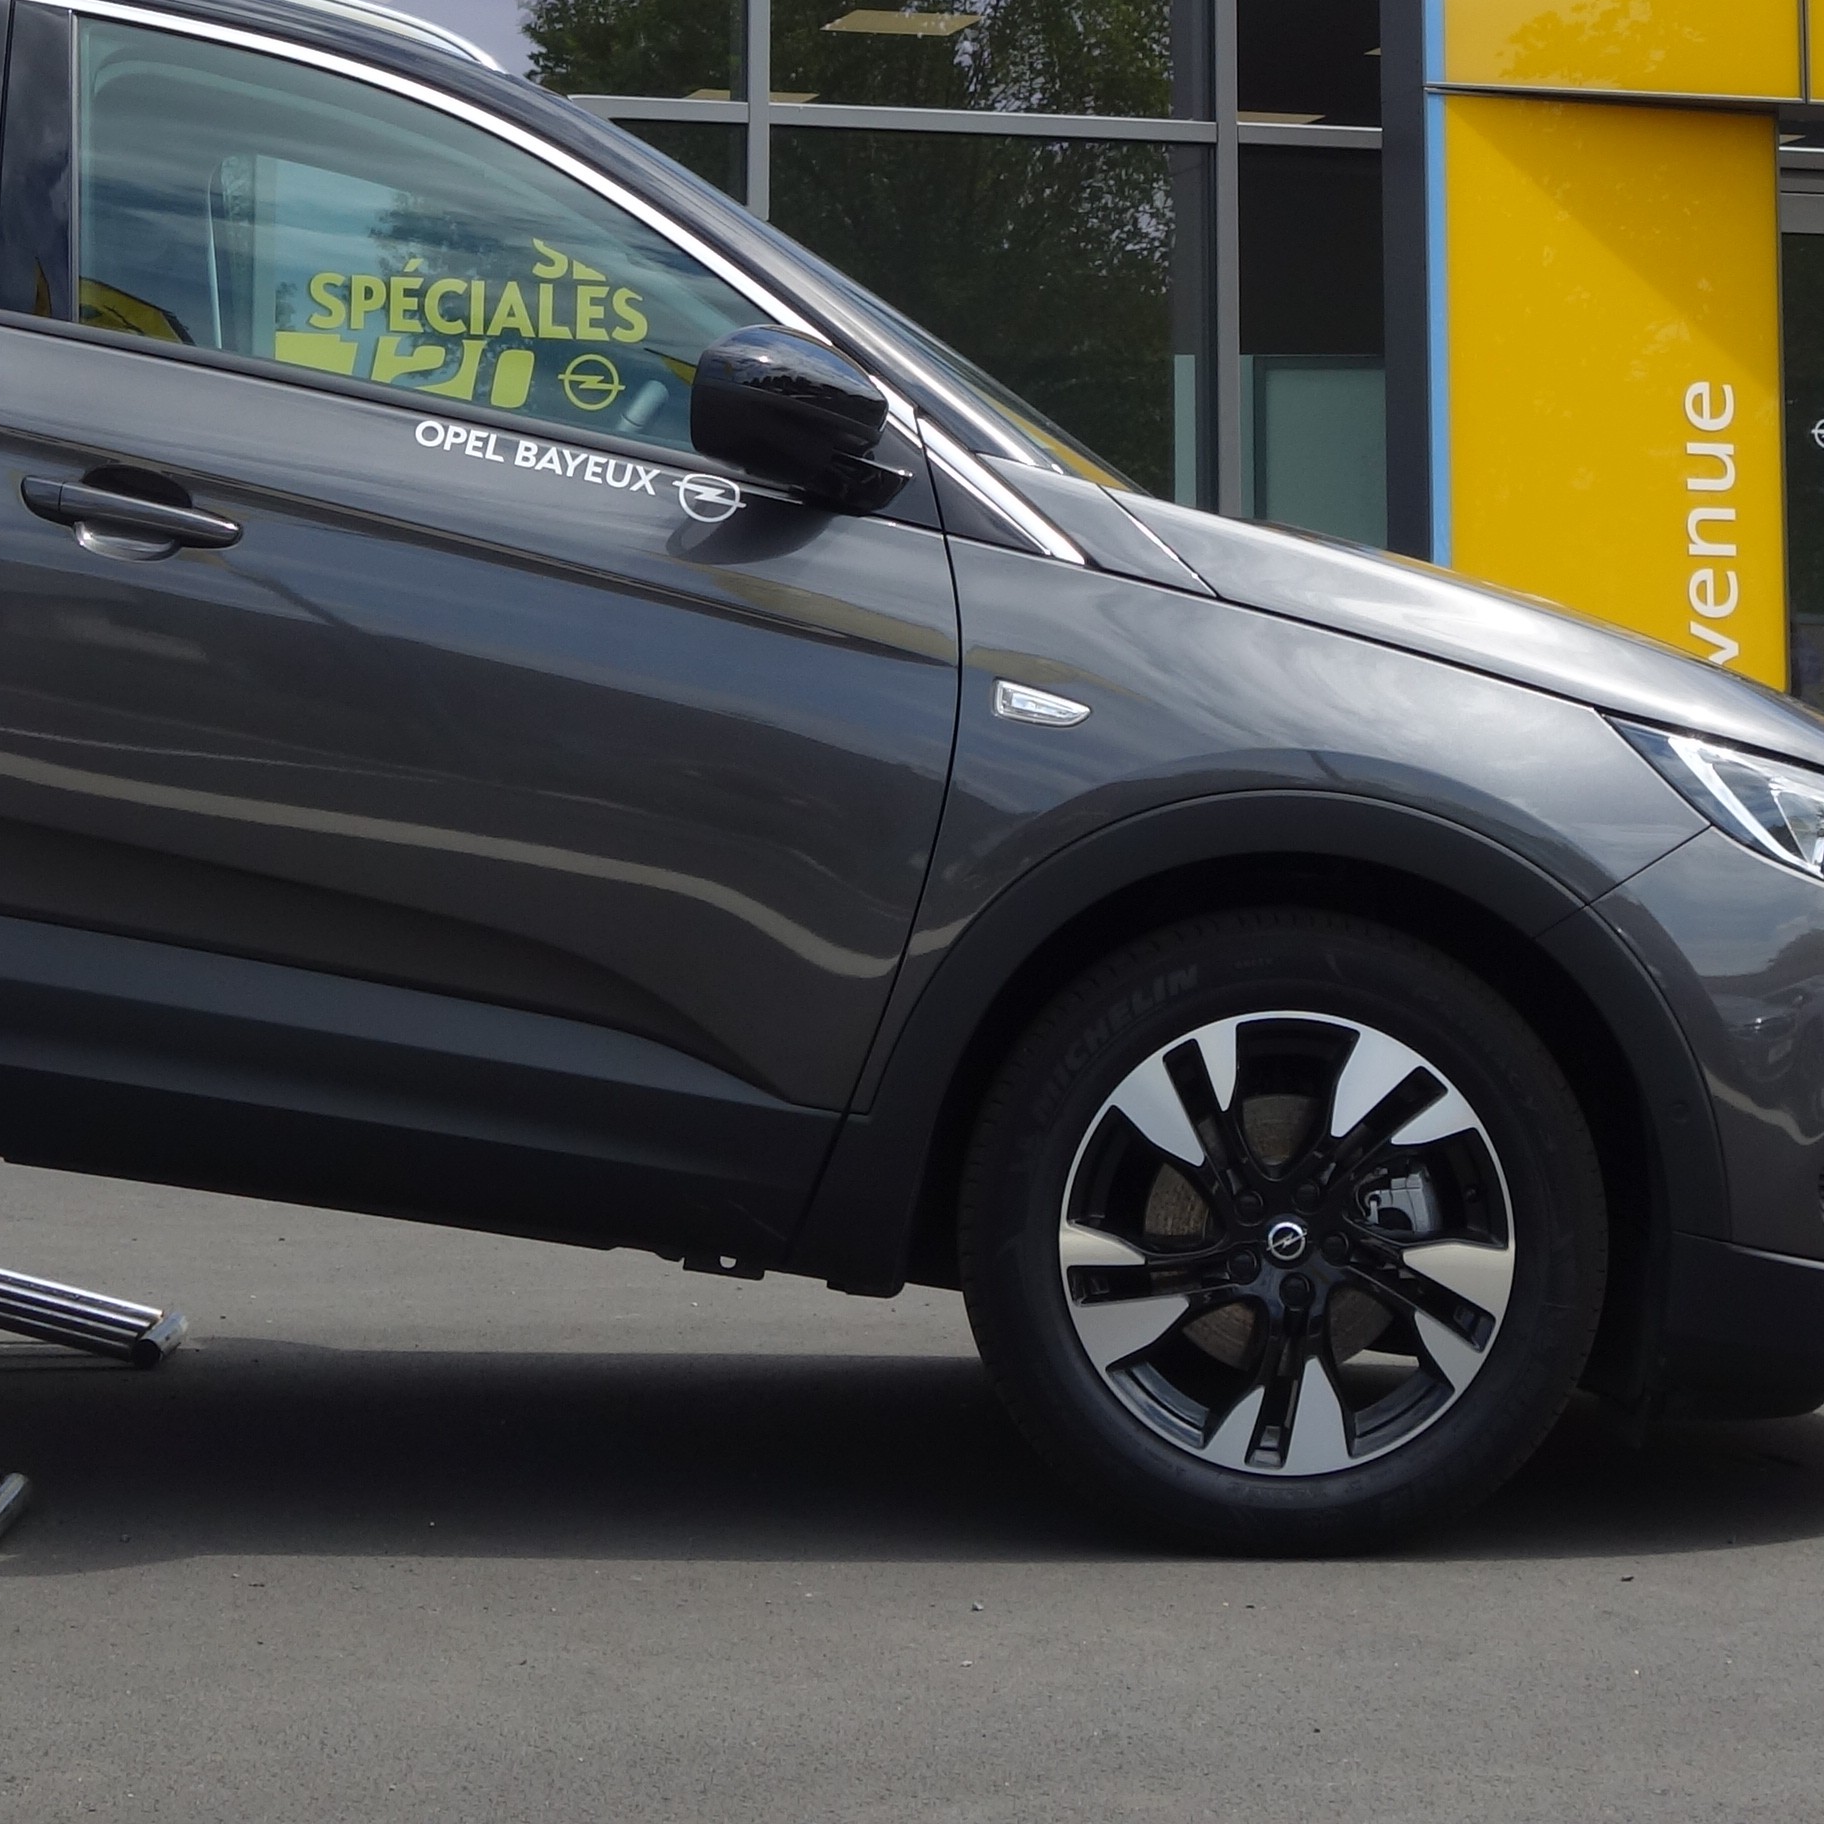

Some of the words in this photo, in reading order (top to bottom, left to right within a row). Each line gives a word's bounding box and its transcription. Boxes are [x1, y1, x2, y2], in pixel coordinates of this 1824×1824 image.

[307, 257, 648, 343] SPÉCIALES
[414, 420, 505, 463] OPEL
[514, 440, 661, 496] BAYEUX
